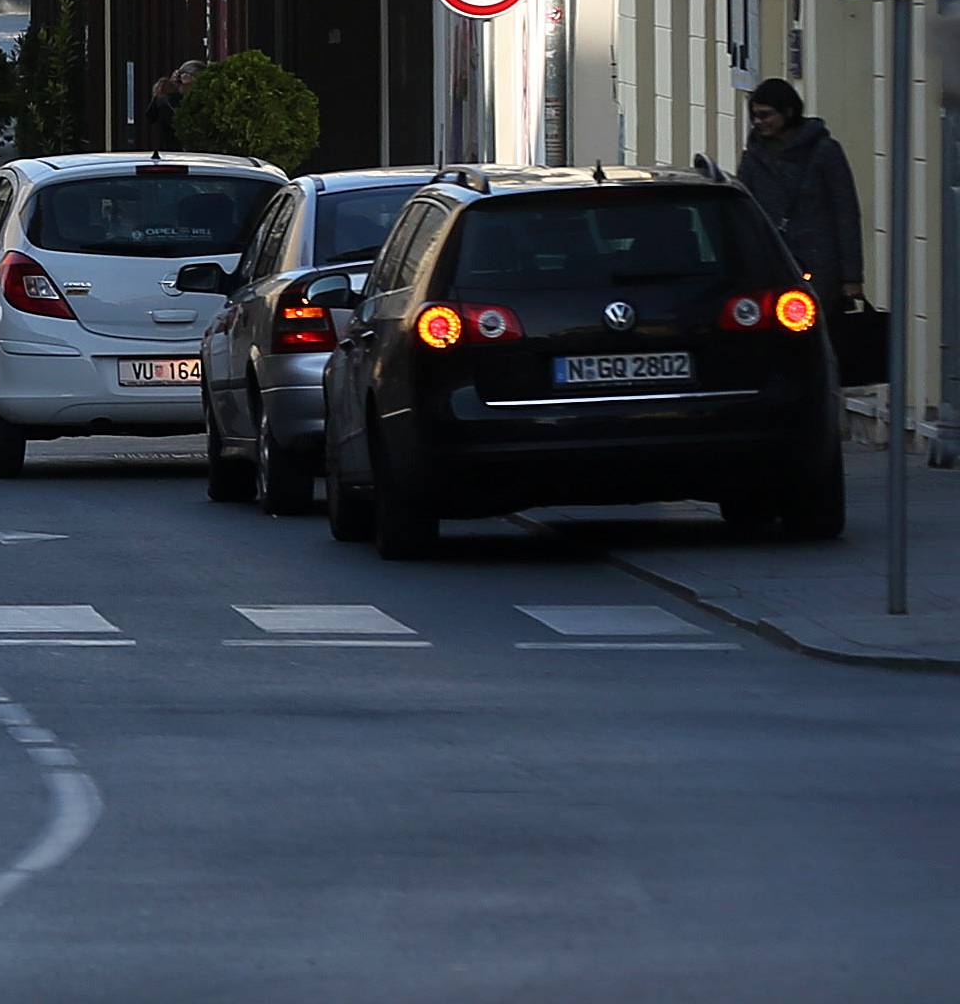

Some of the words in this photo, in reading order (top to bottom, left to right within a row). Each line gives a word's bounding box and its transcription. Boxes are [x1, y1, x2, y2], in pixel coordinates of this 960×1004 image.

[145, 227, 177, 235] OPEL
[132, 361, 154, 381] VU
[169, 361, 201, 381] 164
[632, 354, 689, 378] 2802
